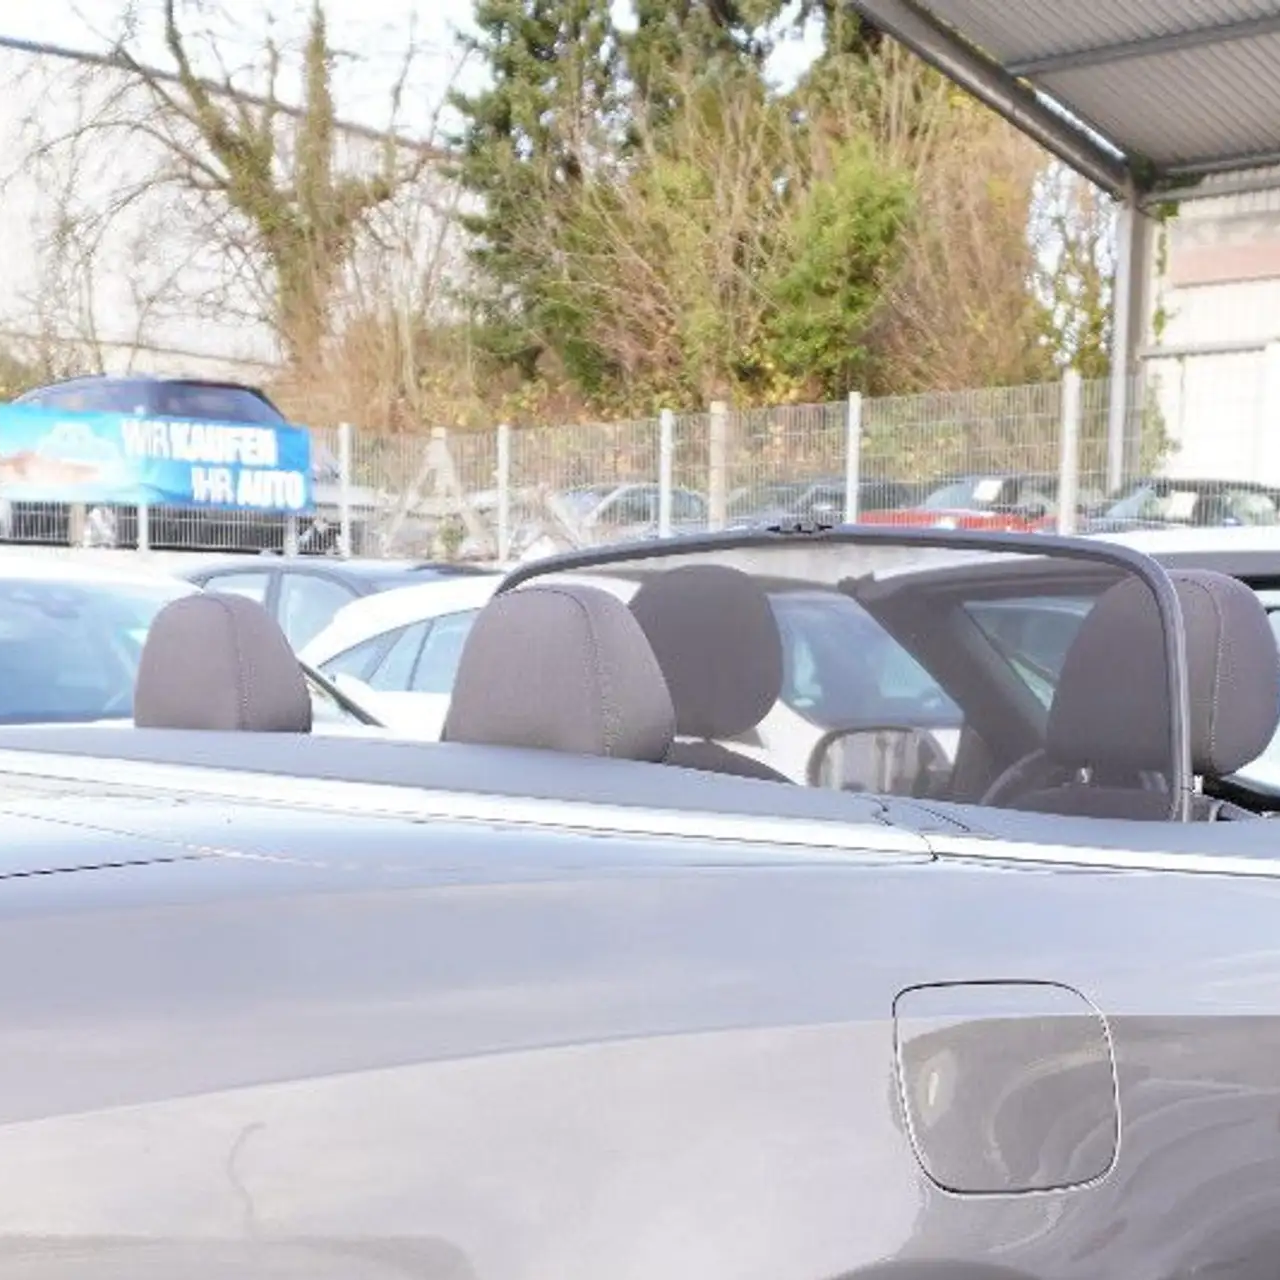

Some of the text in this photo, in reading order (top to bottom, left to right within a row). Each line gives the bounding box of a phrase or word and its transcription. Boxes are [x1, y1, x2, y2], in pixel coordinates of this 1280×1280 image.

[125, 420, 277, 466] WIR KAUFEN
[238, 470, 305, 509] AUTO
